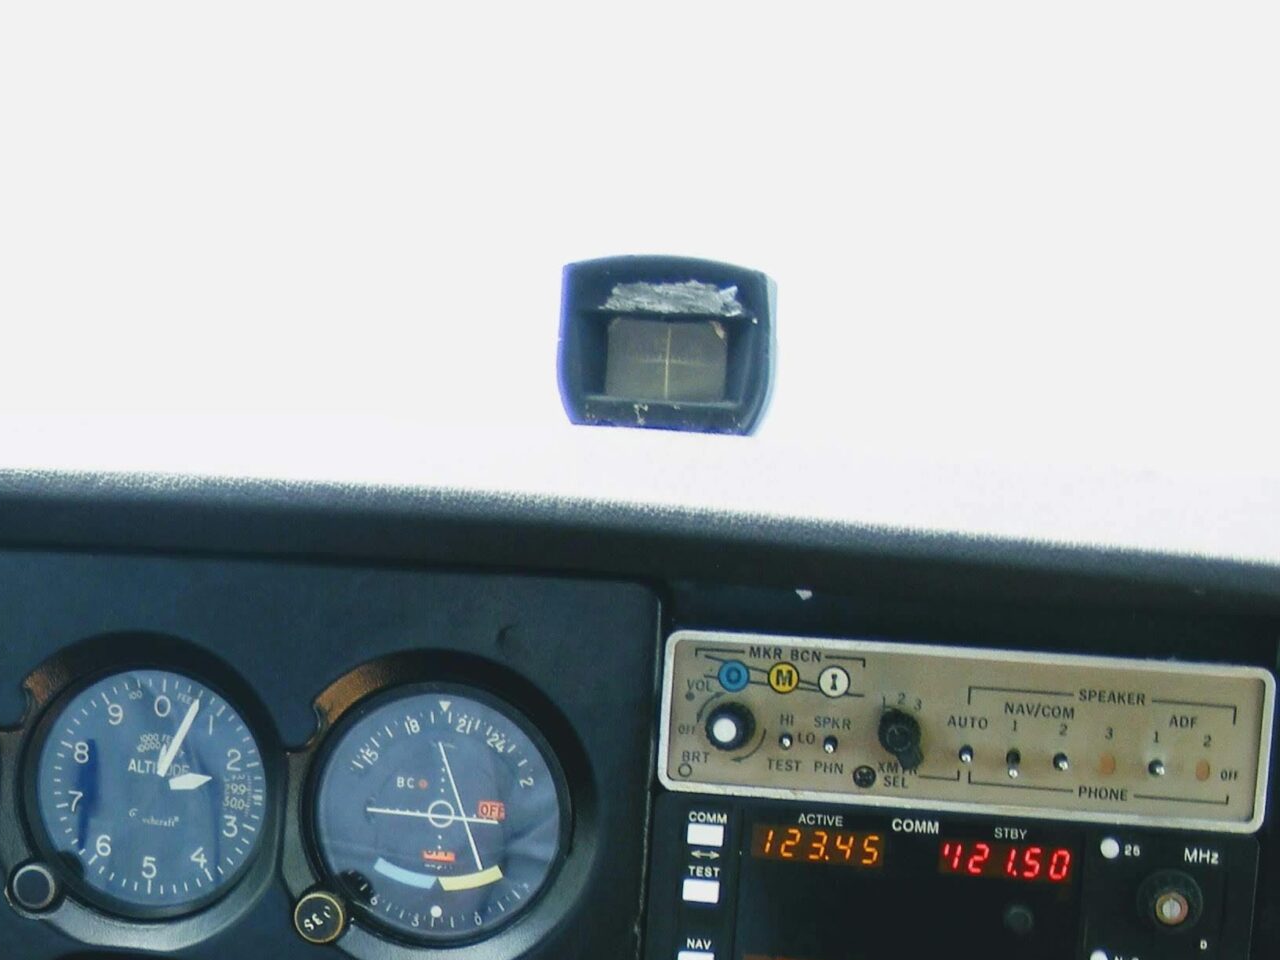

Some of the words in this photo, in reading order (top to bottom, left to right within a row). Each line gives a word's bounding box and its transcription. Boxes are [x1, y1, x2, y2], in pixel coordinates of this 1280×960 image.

[749, 646, 782, 660] MKR
[790, 648, 822, 662] BCN
[1078, 689, 1146, 706] SPEAKER
[1004, 702, 1075, 720] NAV/COM
[456, 718, 471, 734] 21
[814, 716, 851, 731] SPKR
[947, 715, 989, 730] AUTO
[1169, 715, 1198, 729] ADF
[486, 734, 505, 752] 24
[227, 749, 241, 771] 2
[682, 751, 710, 764] BRT
[767, 759, 802, 773] TEST
[814, 761, 844, 775] PHN
[884, 775, 909, 788] SEL
[1078, 786, 1128, 801] PHONE
[69, 791, 83, 812] 7
[689, 811, 727, 824] COMM
[798, 813, 844, 827] ACTIVE
[223, 815, 238, 837] 3
[892, 818, 940, 834] COMM
[994, 828, 1028, 840] STBY
[96, 835, 111, 856] 6
[763, 828, 880, 865] 123.45
[1184, 848, 1219, 865] MHz
[142, 857, 156, 878] 5
[689, 865, 720, 878] TEST
[687, 938, 712, 950] NAV
